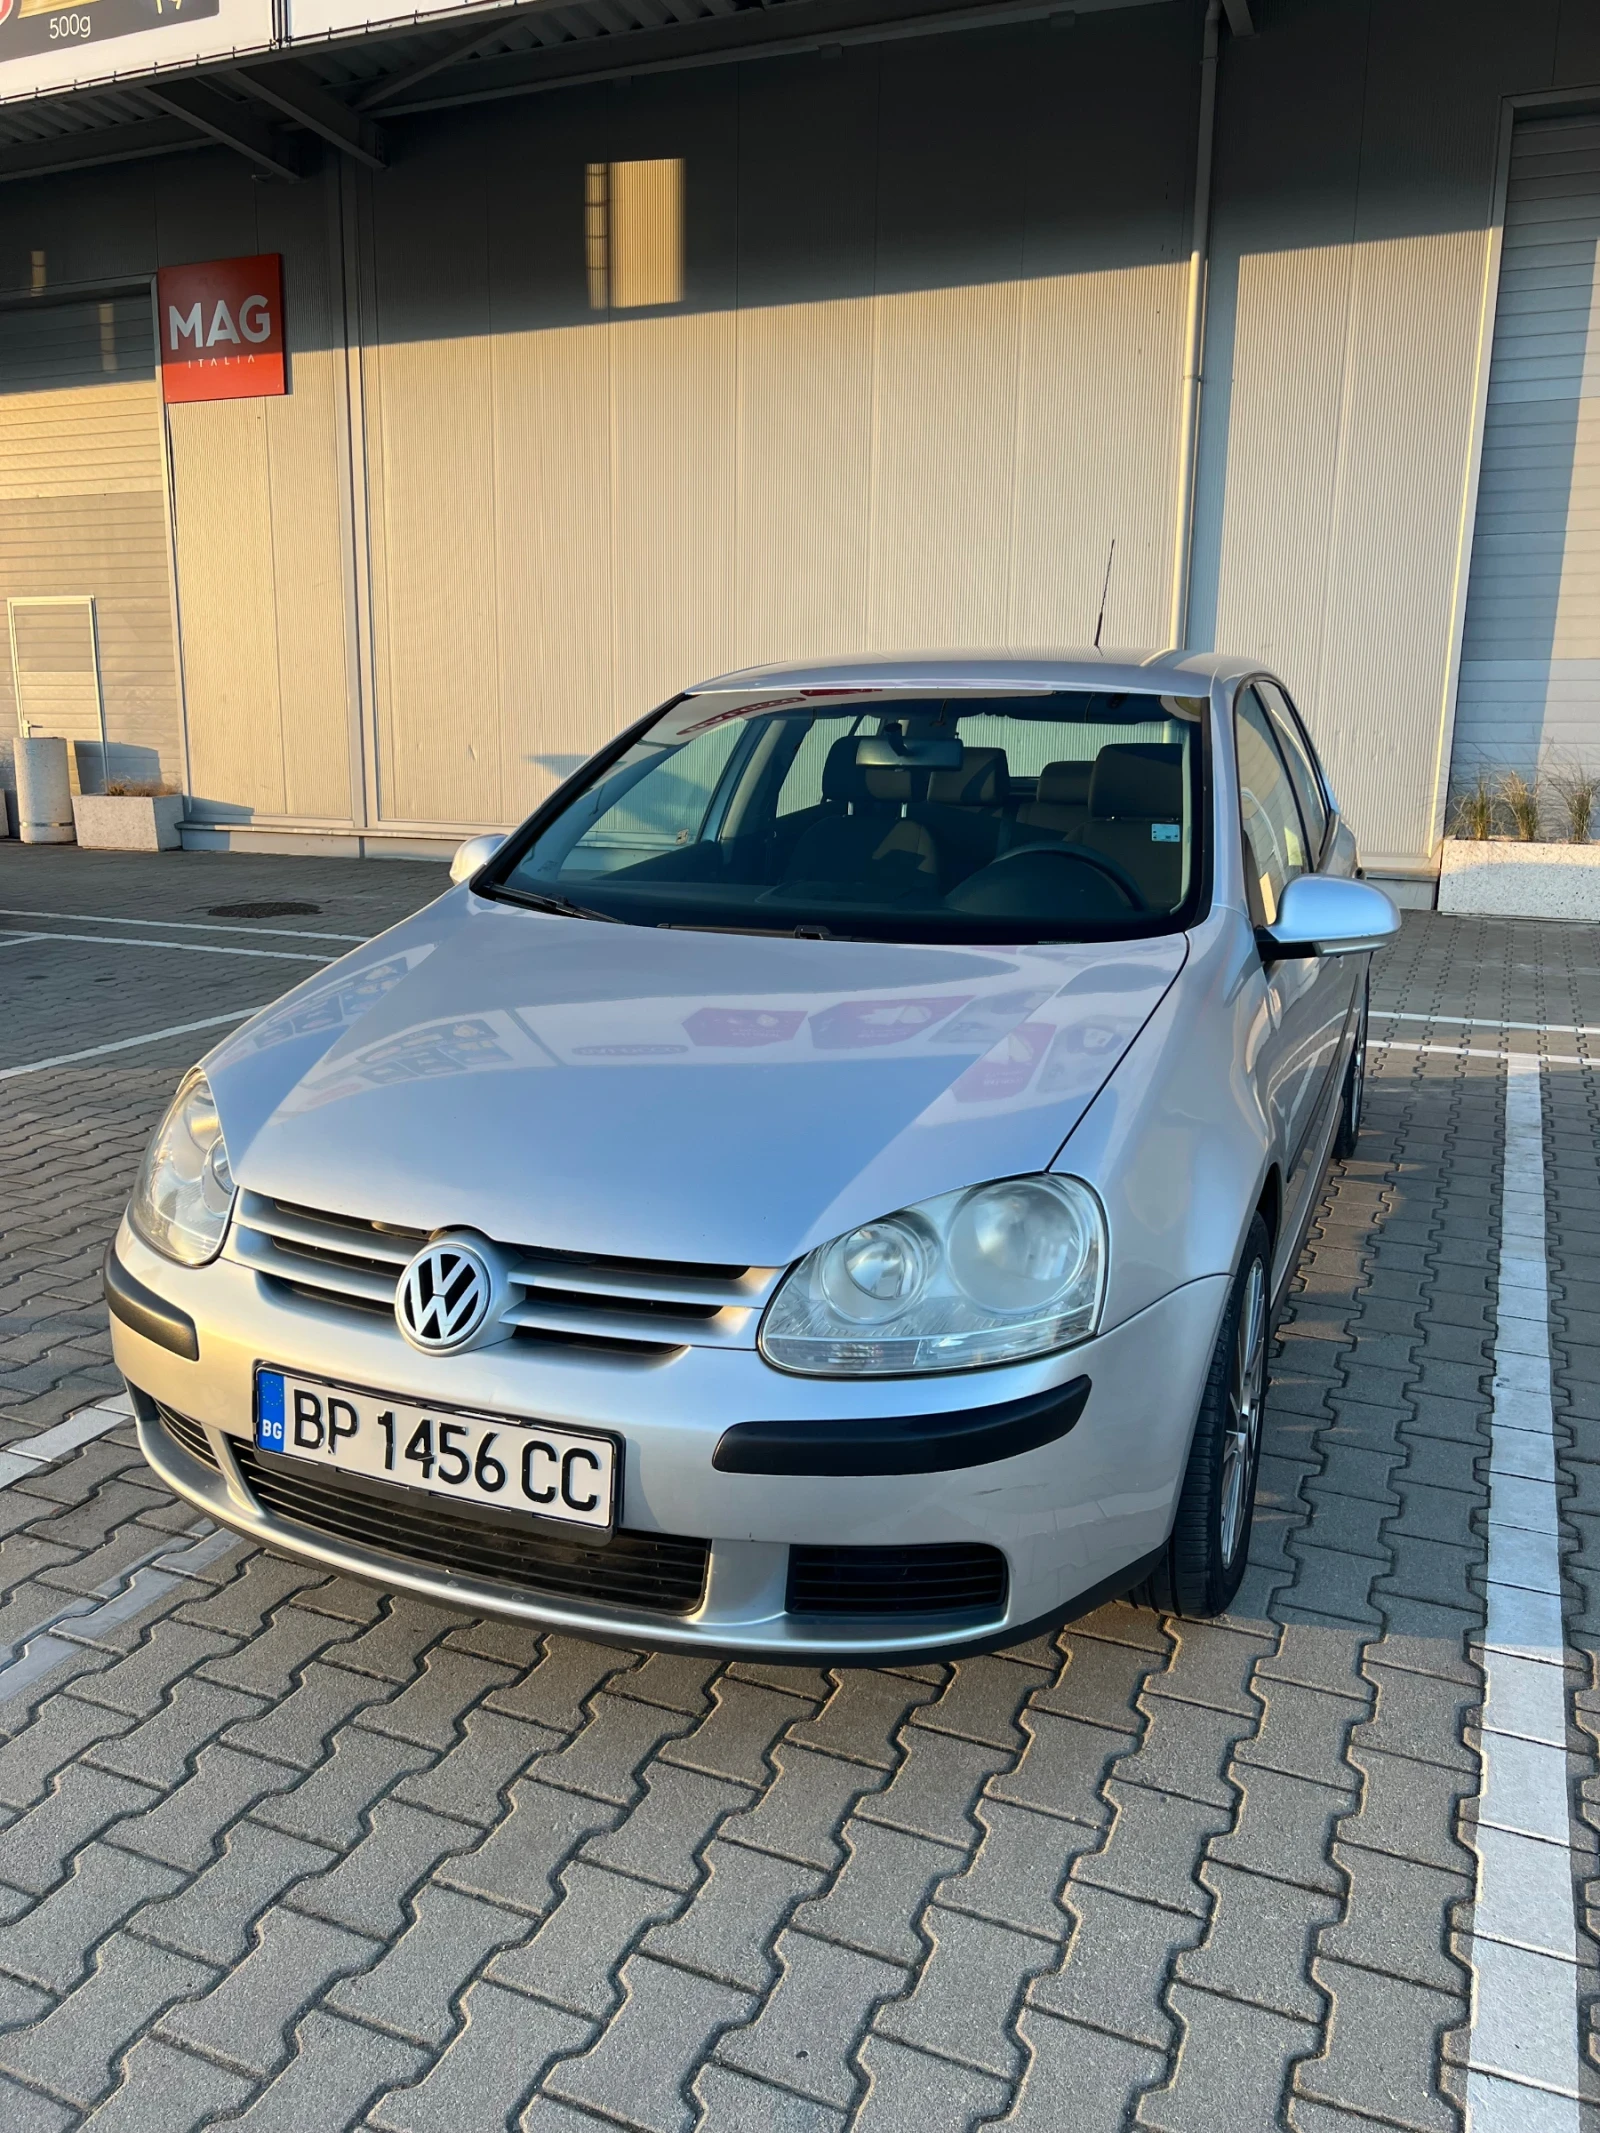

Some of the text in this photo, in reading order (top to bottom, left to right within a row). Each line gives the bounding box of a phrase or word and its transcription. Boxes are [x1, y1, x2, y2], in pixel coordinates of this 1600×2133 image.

[49, 13, 91, 39] 500g
[169, 295, 271, 350] MAG
[188, 354, 255, 369] ITALIA
[262, 1418, 282, 1440] BG
[293, 1388, 600, 1513] BP 1456 CC
